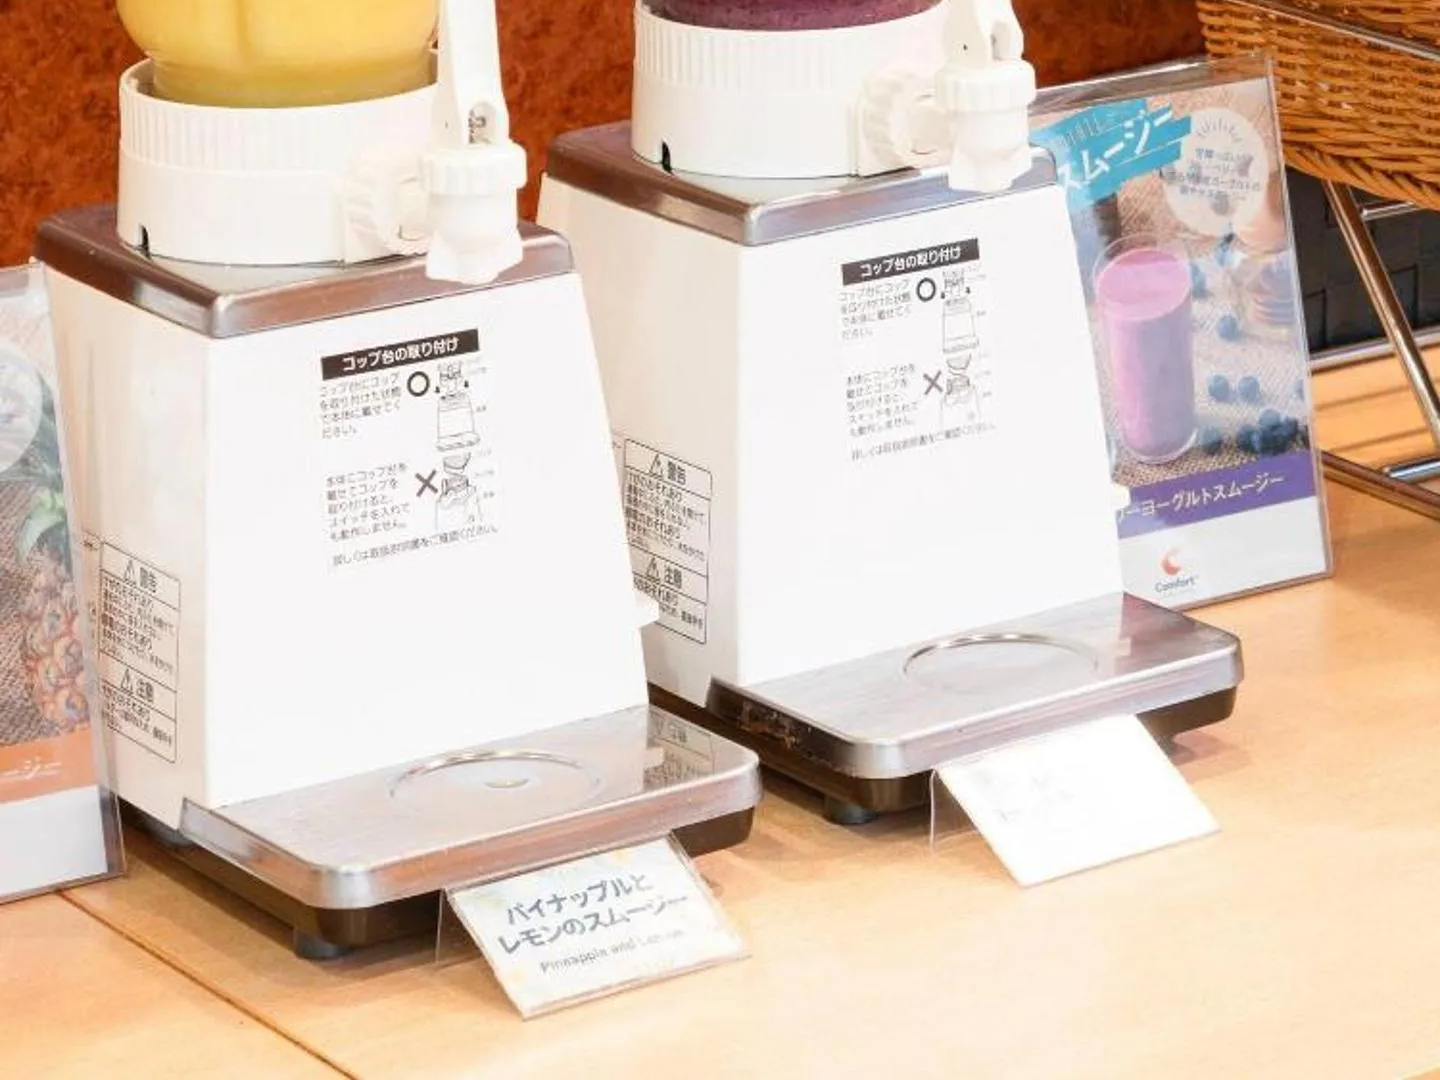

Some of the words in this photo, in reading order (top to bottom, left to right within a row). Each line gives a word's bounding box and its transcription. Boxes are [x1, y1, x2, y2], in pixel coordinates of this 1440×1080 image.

[859, 245, 963, 278] コップ台の取り付け
[342, 336, 460, 372] コップ台の取り付け
[506, 872, 654, 926] パイナップルと
[497, 895, 689, 955] レモンのスムージー
